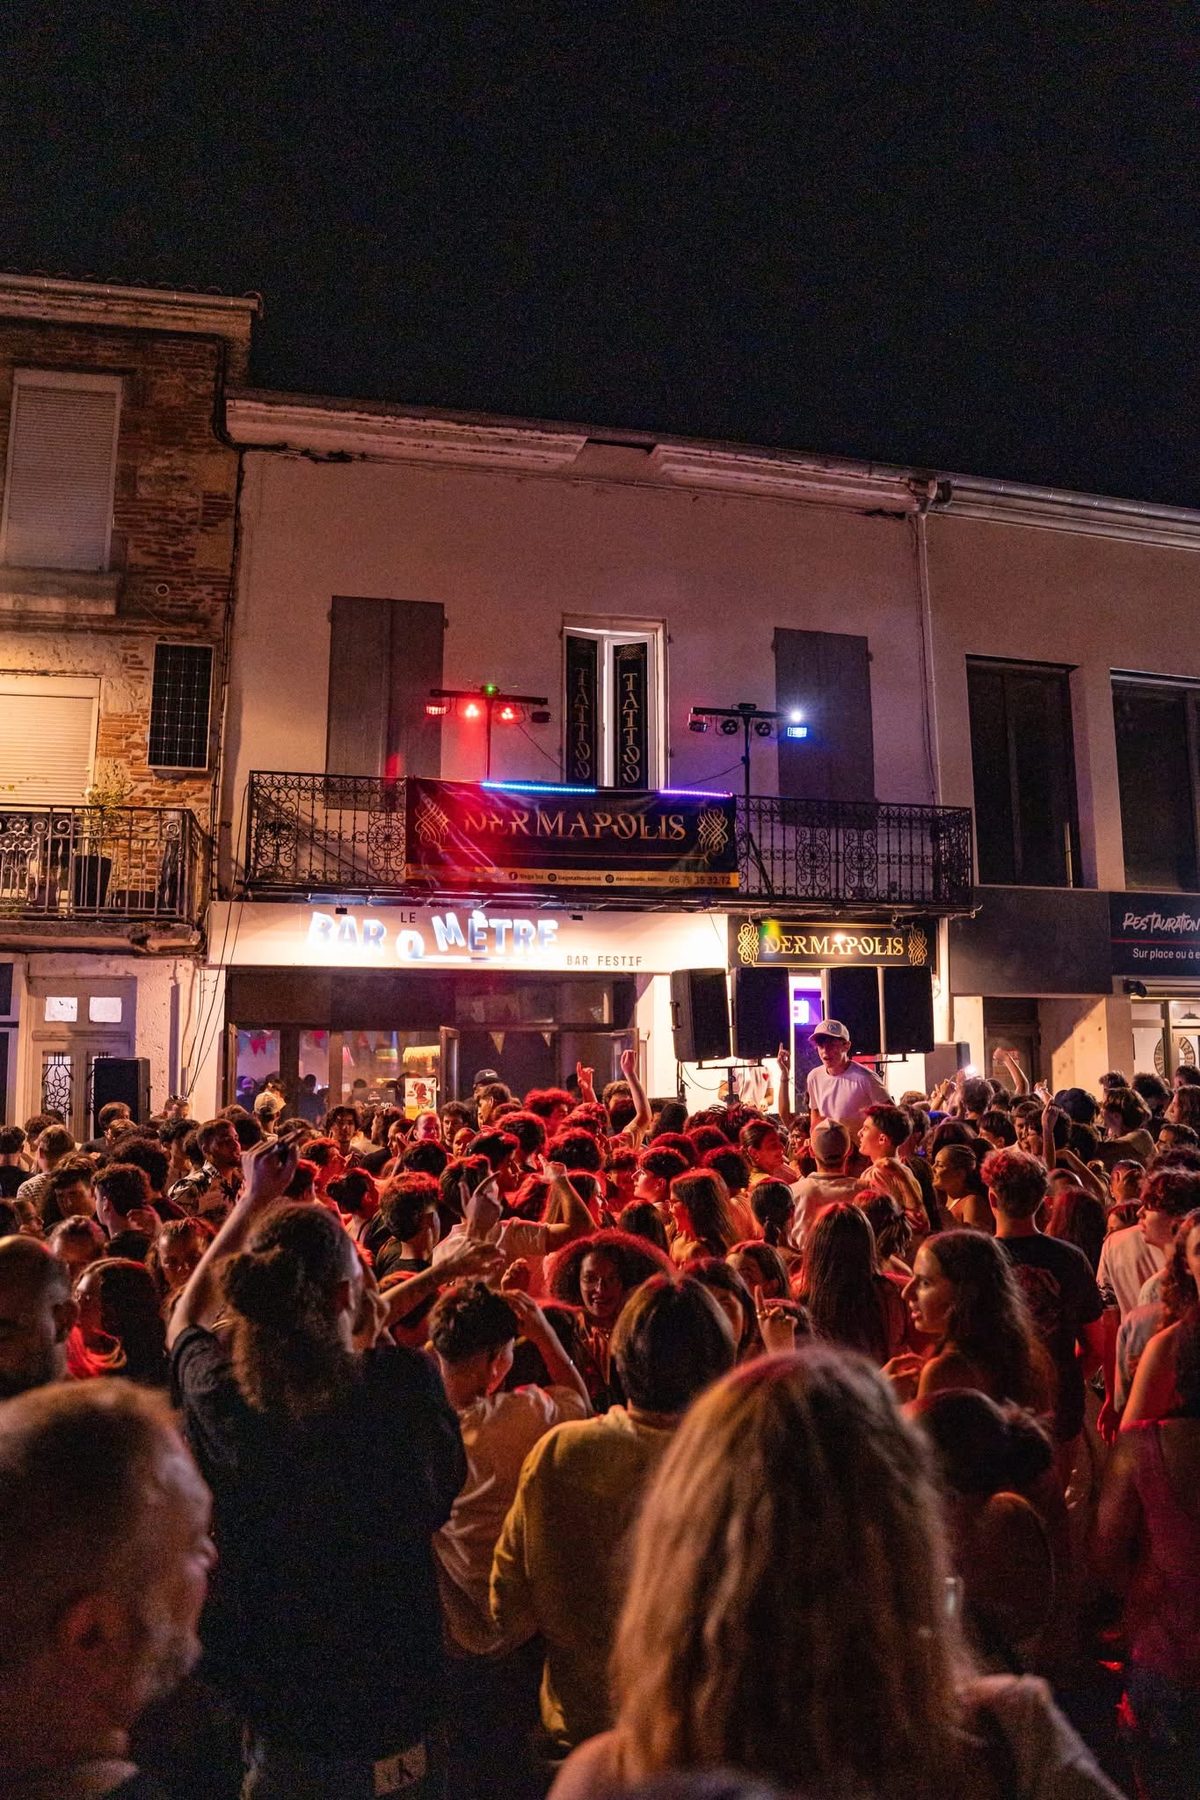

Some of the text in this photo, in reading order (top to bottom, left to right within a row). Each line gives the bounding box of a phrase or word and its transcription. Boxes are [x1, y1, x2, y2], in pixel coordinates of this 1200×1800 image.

[400, 912, 417, 923] LE
[307, 911, 387, 955] BAR
[764, 935, 904, 956] DERMAPOLIS
[1132, 948, 1148, 958] Sur
[1149, 948, 1174, 960] place
[1175, 950, 1187, 959] ou
[1188, 949, 1194, 959] à
[566, 955, 643, 967] BAR FESTIF
